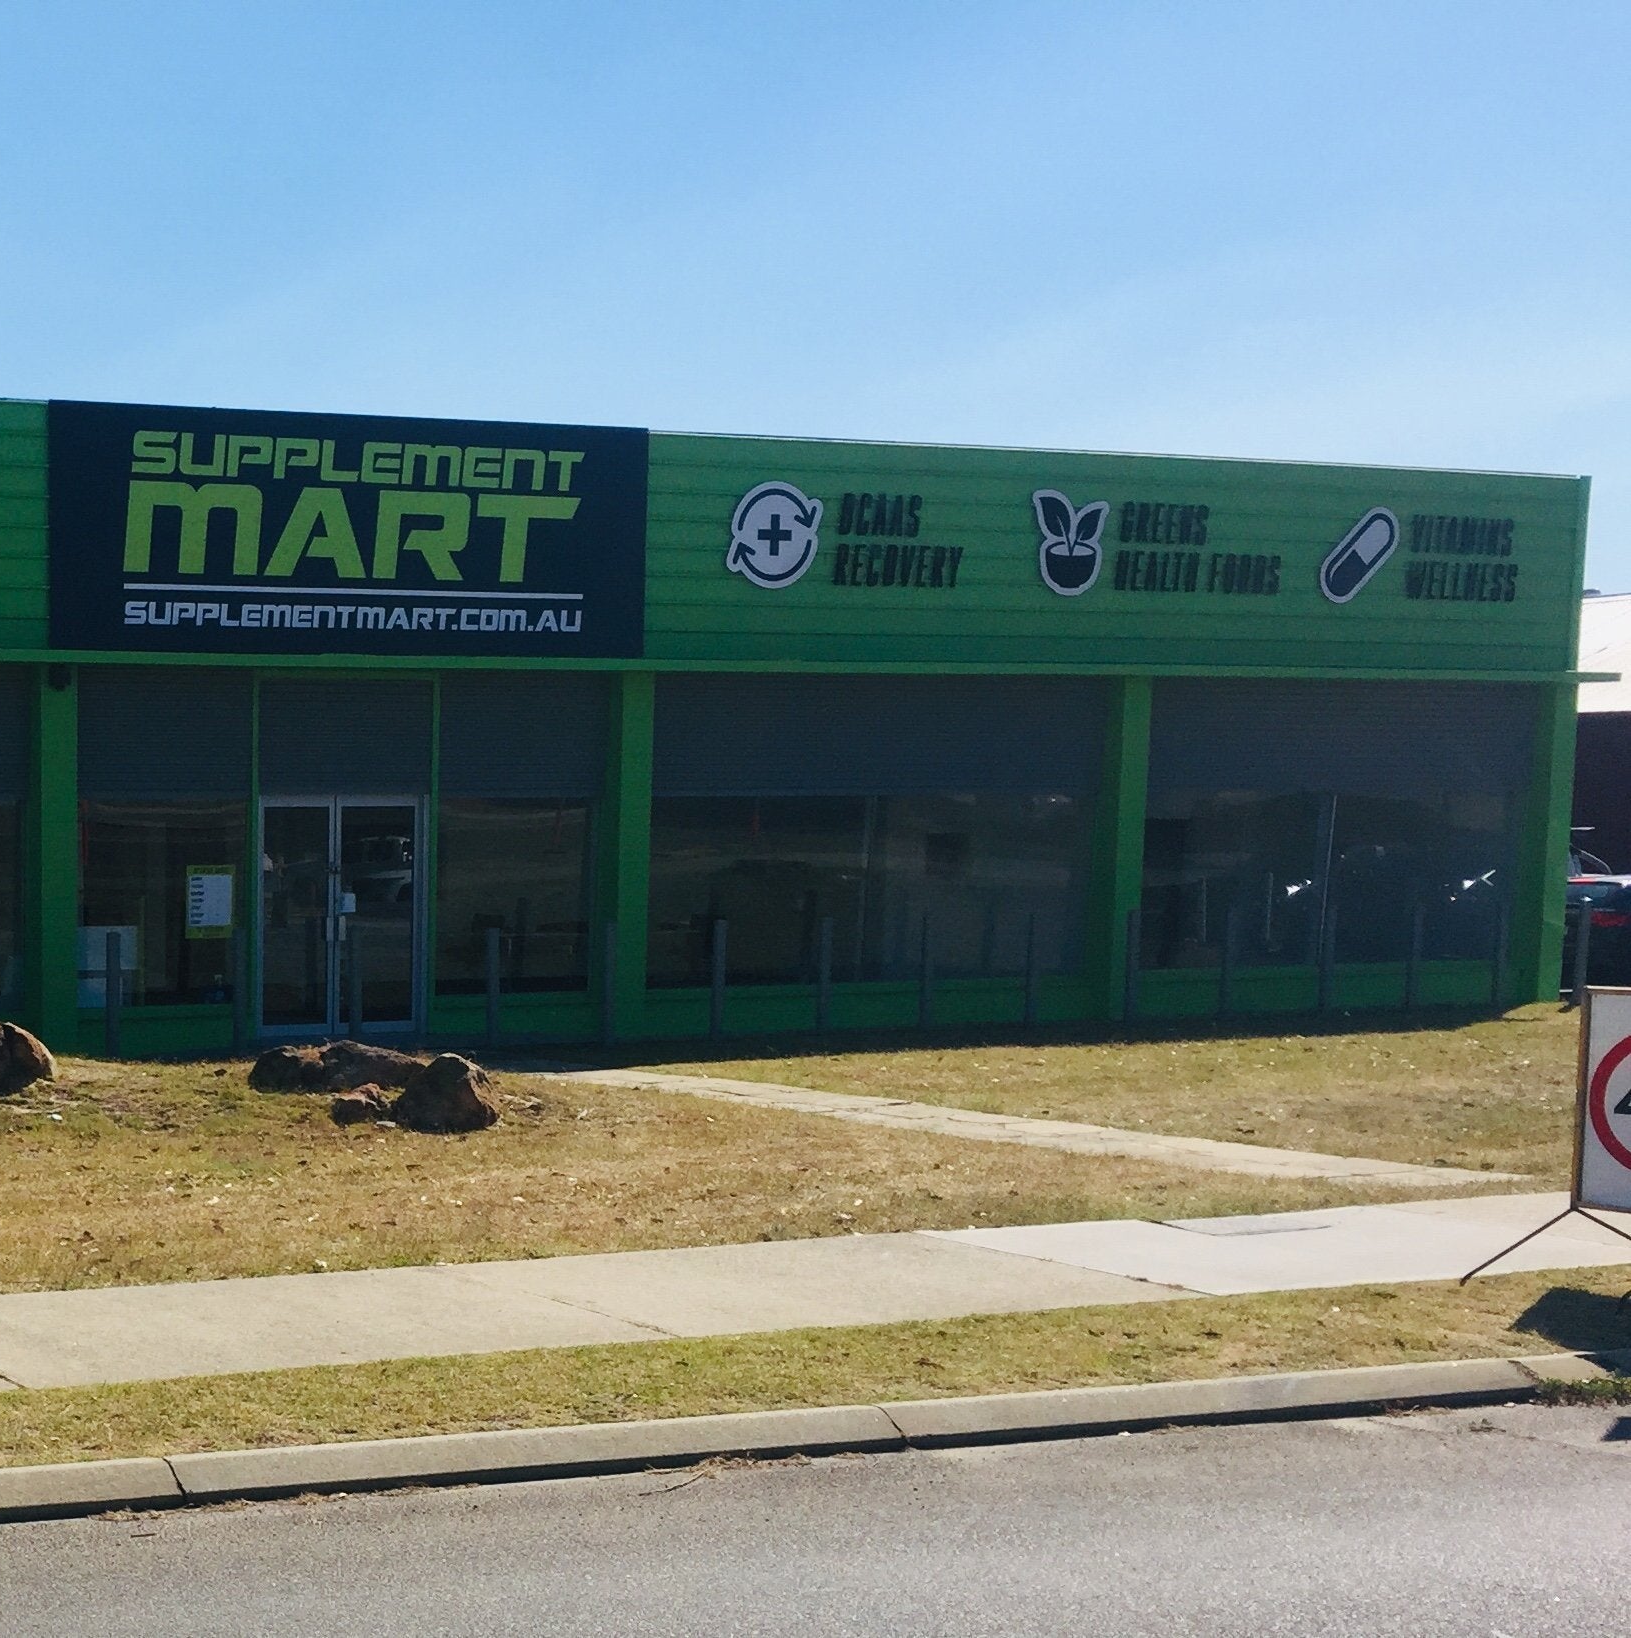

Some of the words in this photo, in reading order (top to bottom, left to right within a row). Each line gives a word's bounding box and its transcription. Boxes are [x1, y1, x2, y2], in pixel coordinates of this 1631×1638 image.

[131, 430, 585, 491] SUPPLEMENT
[123, 480, 581, 582] MART
[1119, 501, 1210, 545] GREENS
[1411, 514, 1515, 556] VITAMINS
[832, 543, 964, 589] RECOVERY
[1114, 550, 1200, 593] HEALTH
[1207, 553, 1282, 595] FOODS
[1405, 560, 1519, 601] WELLNESS
[124, 601, 582, 632] SUPPLEMENTMART.COM.AU
